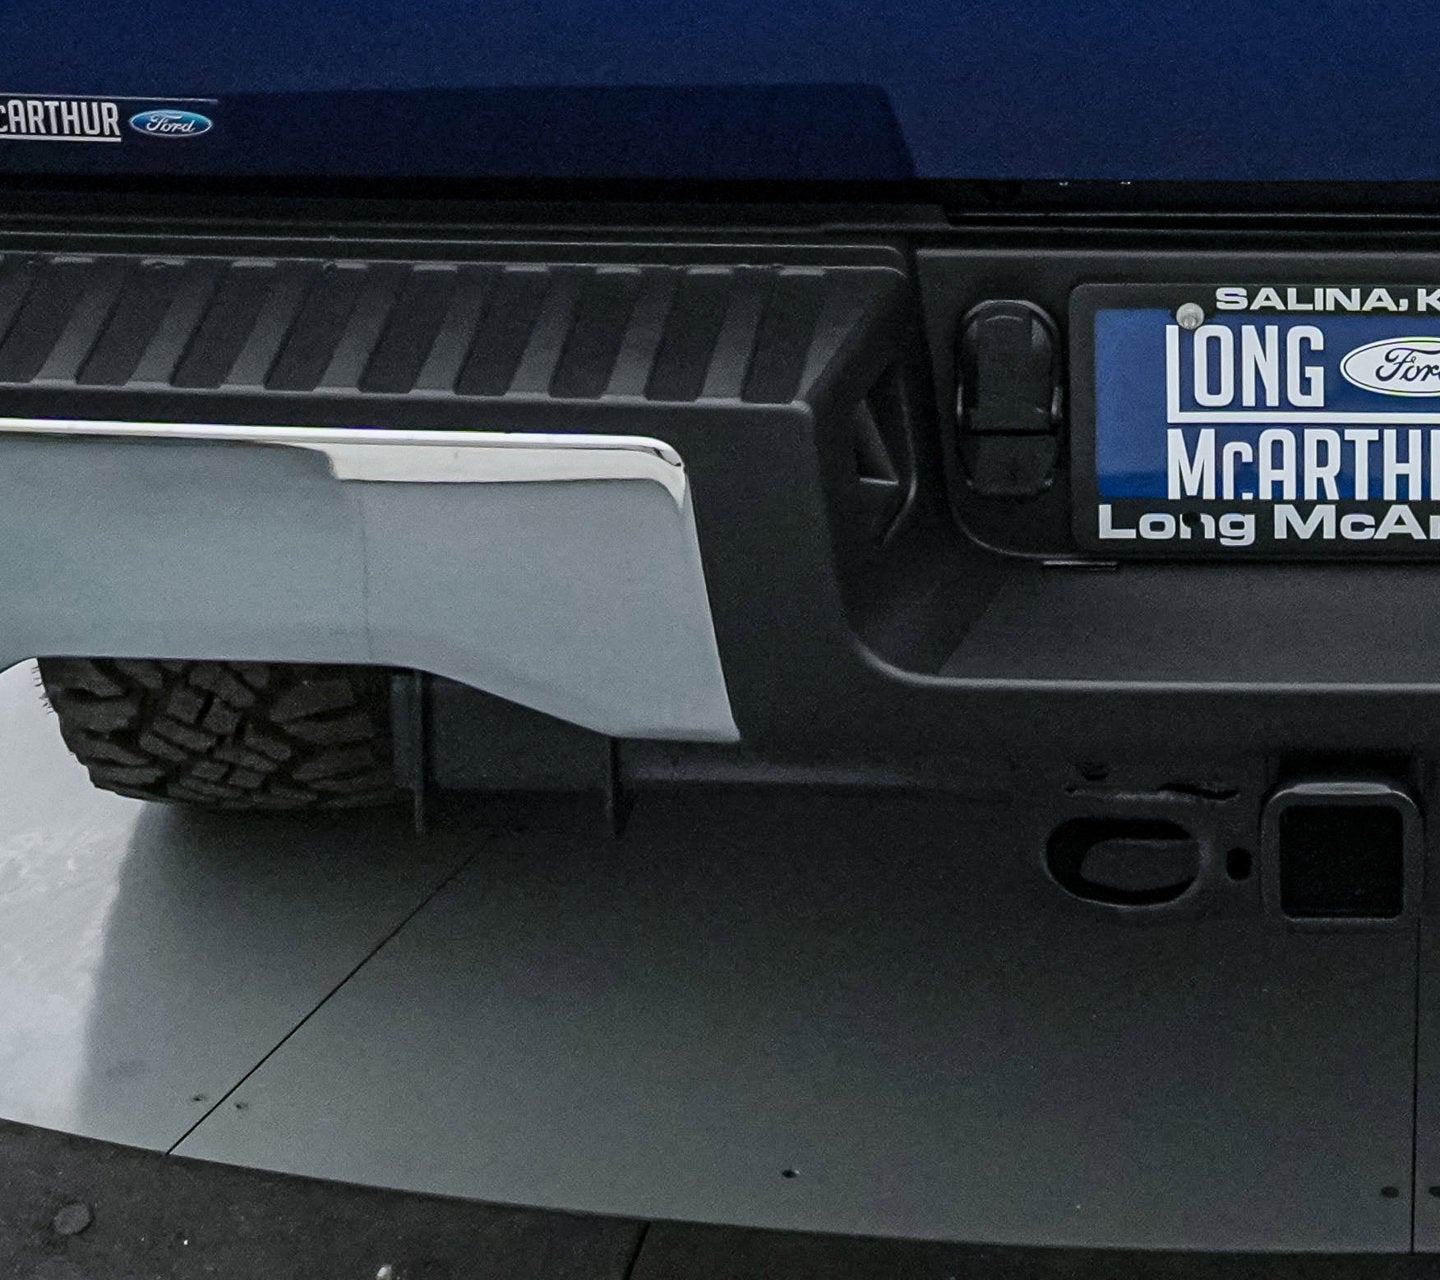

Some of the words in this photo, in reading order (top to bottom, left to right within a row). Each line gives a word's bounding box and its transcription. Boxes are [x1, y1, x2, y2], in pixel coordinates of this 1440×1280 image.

[1215, 287, 1410, 312] SALINA,
[1166, 324, 1326, 424] LONG
[1098, 503, 1256, 547] Long
